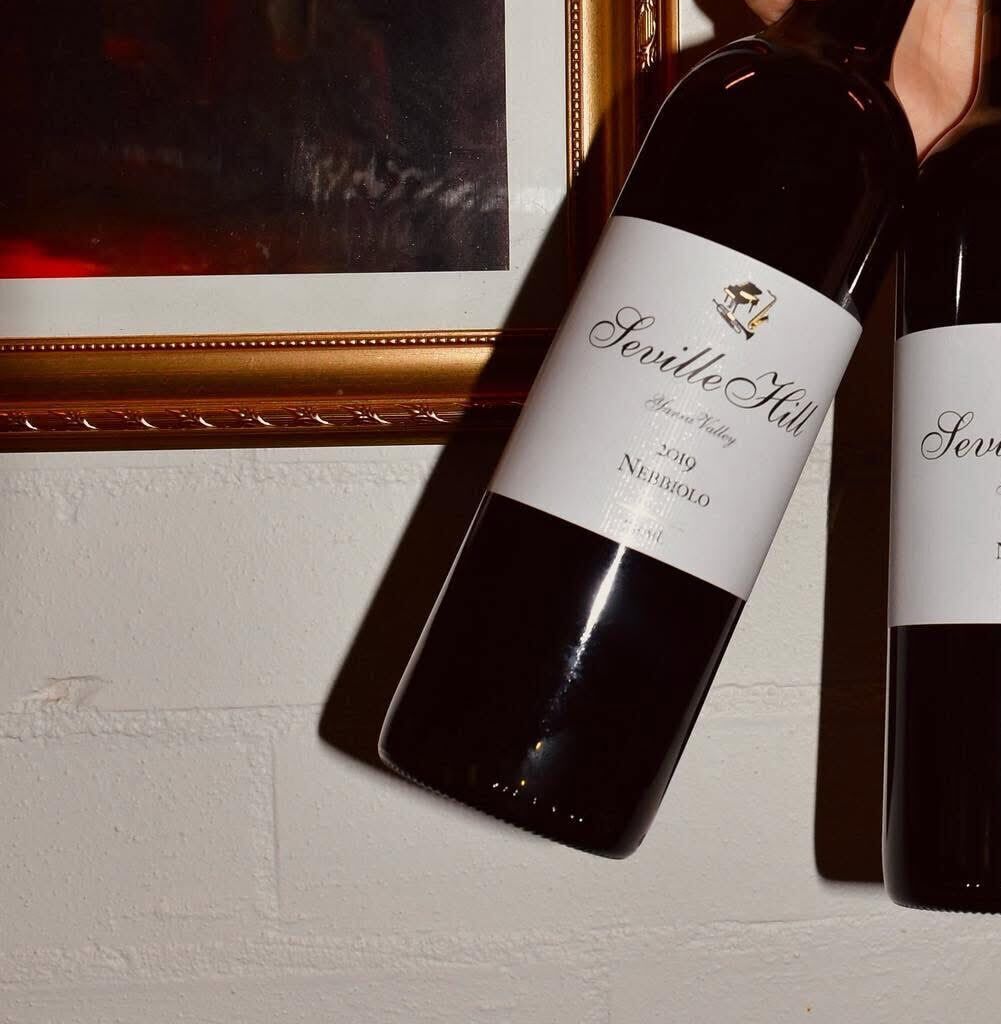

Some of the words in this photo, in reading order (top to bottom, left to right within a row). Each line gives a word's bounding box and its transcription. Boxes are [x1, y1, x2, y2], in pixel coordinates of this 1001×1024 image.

[588, 306, 724, 392] Seville
[724, 371, 819, 438] Hill
[644, 393, 696, 425] Yarra
[695, 412, 738, 448] Valley
[655, 442, 697, 472] 2019
